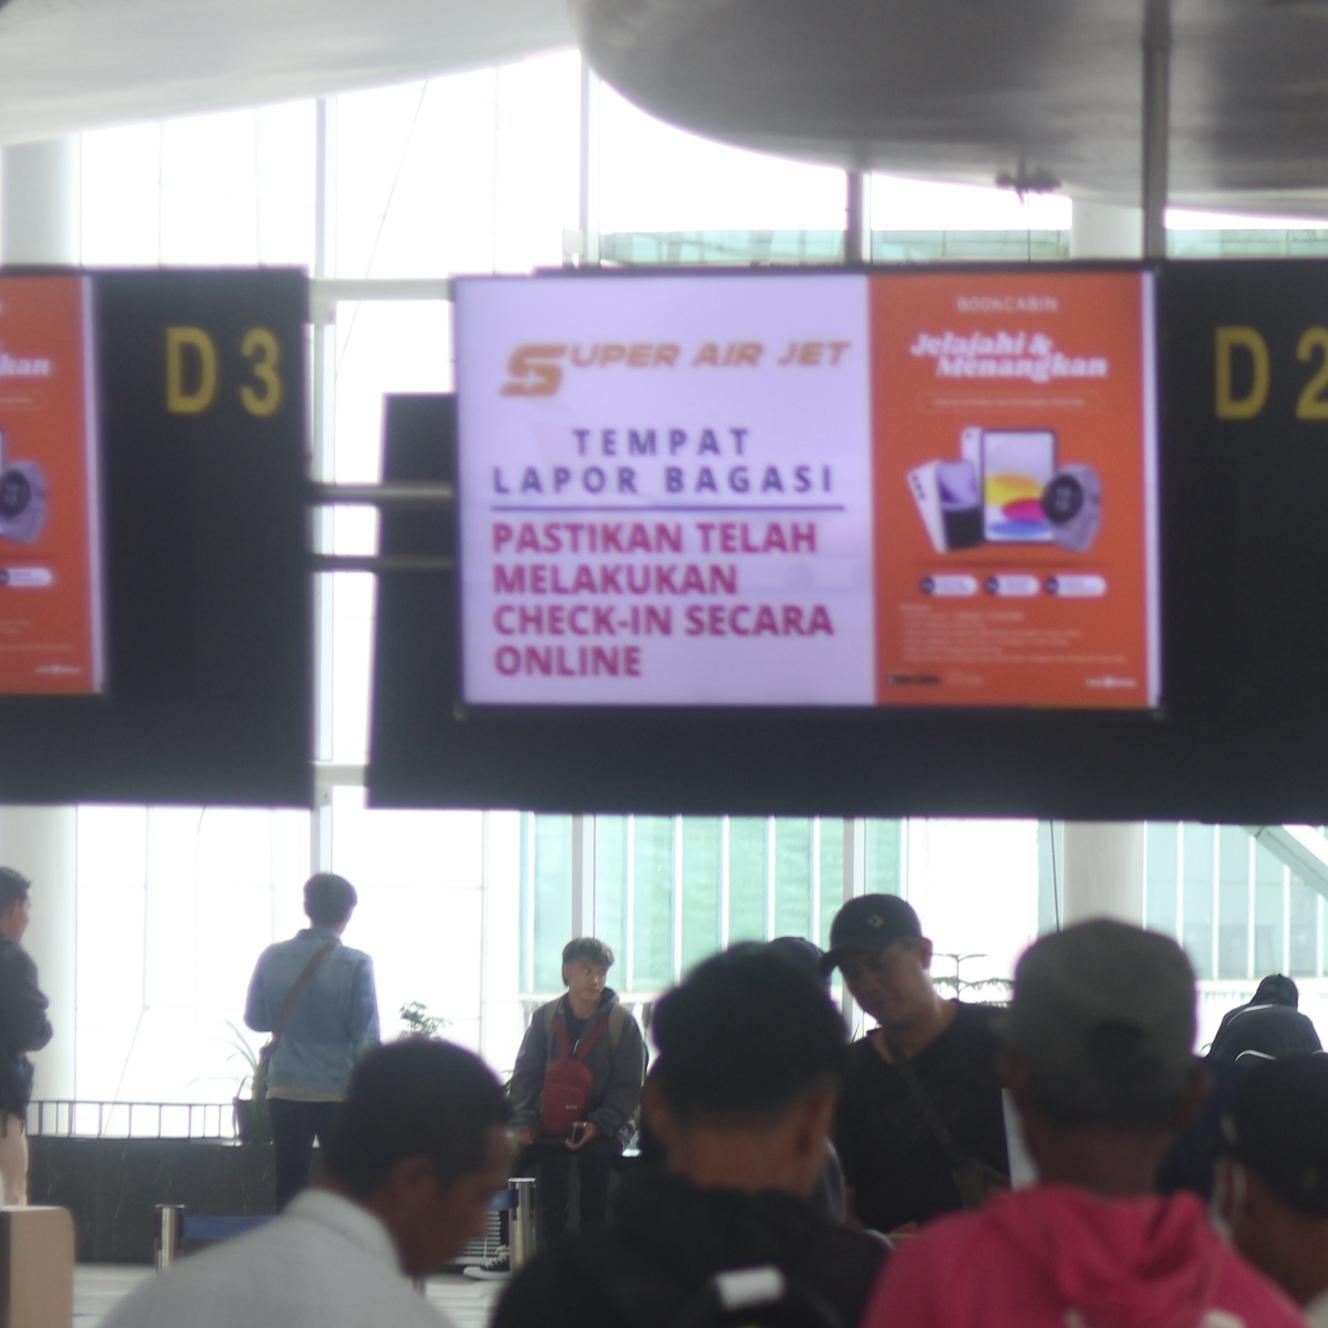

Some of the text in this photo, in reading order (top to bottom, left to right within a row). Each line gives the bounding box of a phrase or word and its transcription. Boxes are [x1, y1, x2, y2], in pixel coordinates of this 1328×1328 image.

[166, 326, 283, 417] D 3
[500, 341, 851, 397] SUPER AIR JET
[935, 353, 1109, 382] Menangkan
[1216, 327, 1271, 419] D
[573, 428, 750, 457] TEMPAT
[493, 465, 832, 494] LAPOR BAGASI
[492, 522, 819, 554] PASTIKAN TELAH
[493, 564, 738, 595] MELAKUKAN
[493, 605, 835, 637] CHECK-IN SECARA
[495, 645, 642, 677] ONLINE
